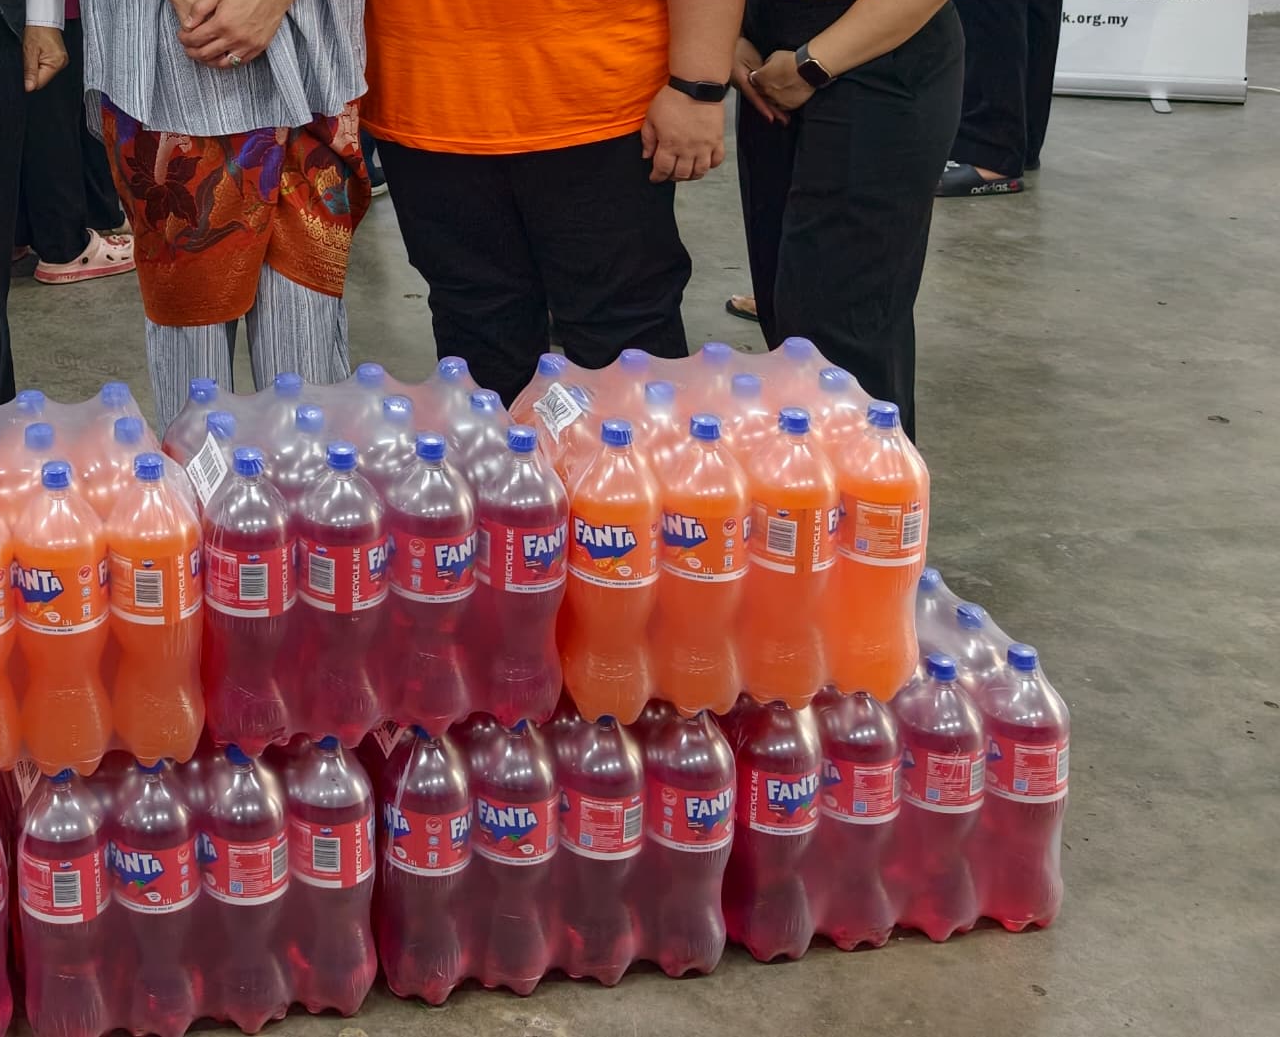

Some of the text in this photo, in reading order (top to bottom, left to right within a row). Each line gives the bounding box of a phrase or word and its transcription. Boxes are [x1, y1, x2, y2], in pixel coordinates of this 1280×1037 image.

[1062, 12, 1128, 27] k.org.my
[523, 522, 567, 557] FANT
[574, 516, 637, 548] FANTA
[505, 528, 514, 584] RECYCLE ME
[352, 547, 360, 602] RECYCLE ME
[478, 798, 538, 828] FANTA
[686, 787, 733, 818] FANT
